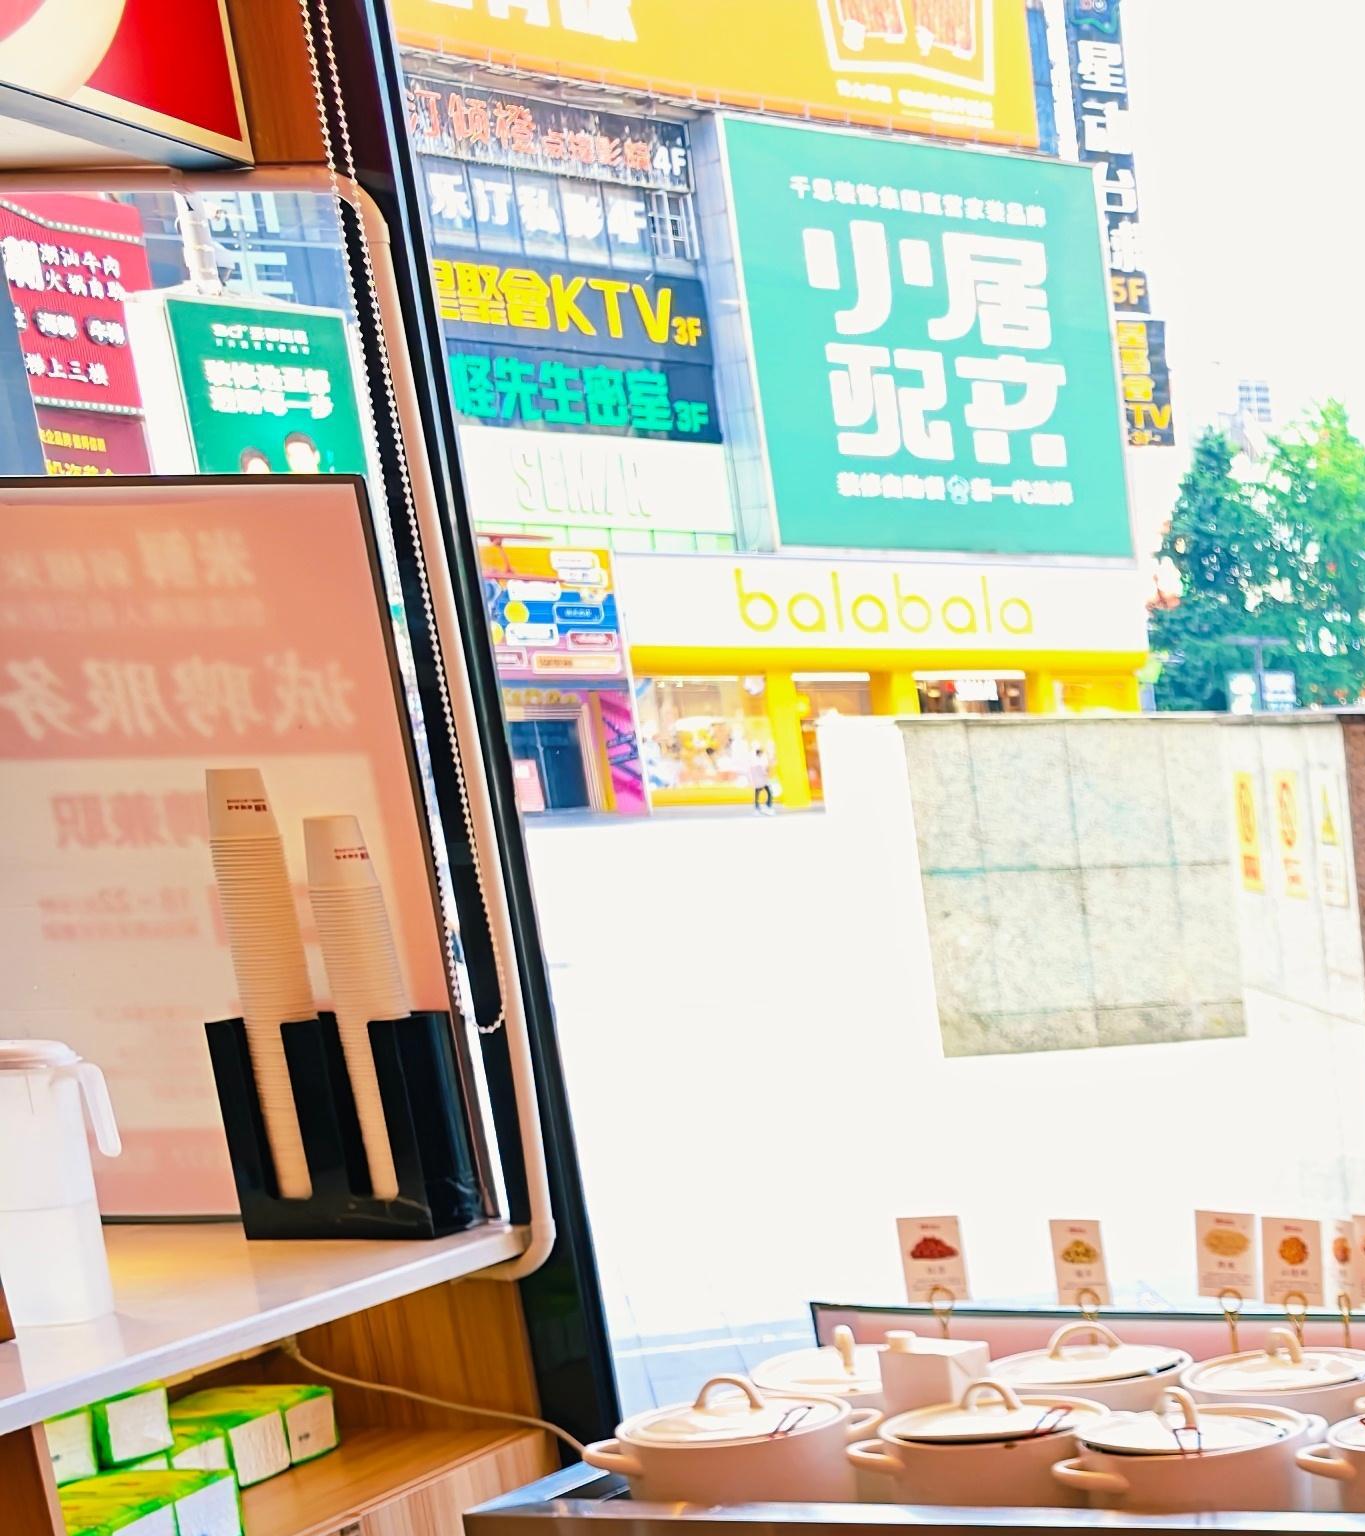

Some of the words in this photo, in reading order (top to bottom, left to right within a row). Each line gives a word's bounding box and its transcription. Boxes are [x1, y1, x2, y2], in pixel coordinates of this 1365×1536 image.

[653, 145, 687, 177] 4F
[802, 219, 1053, 349] 小居
[1112, 276, 1146, 304] 5F
[672, 316, 702, 347] 3F
[450, 352, 673, 432] 怪先生密室
[673, 401, 710, 433] 3F
[735, 568, 1033, 635] balabala
